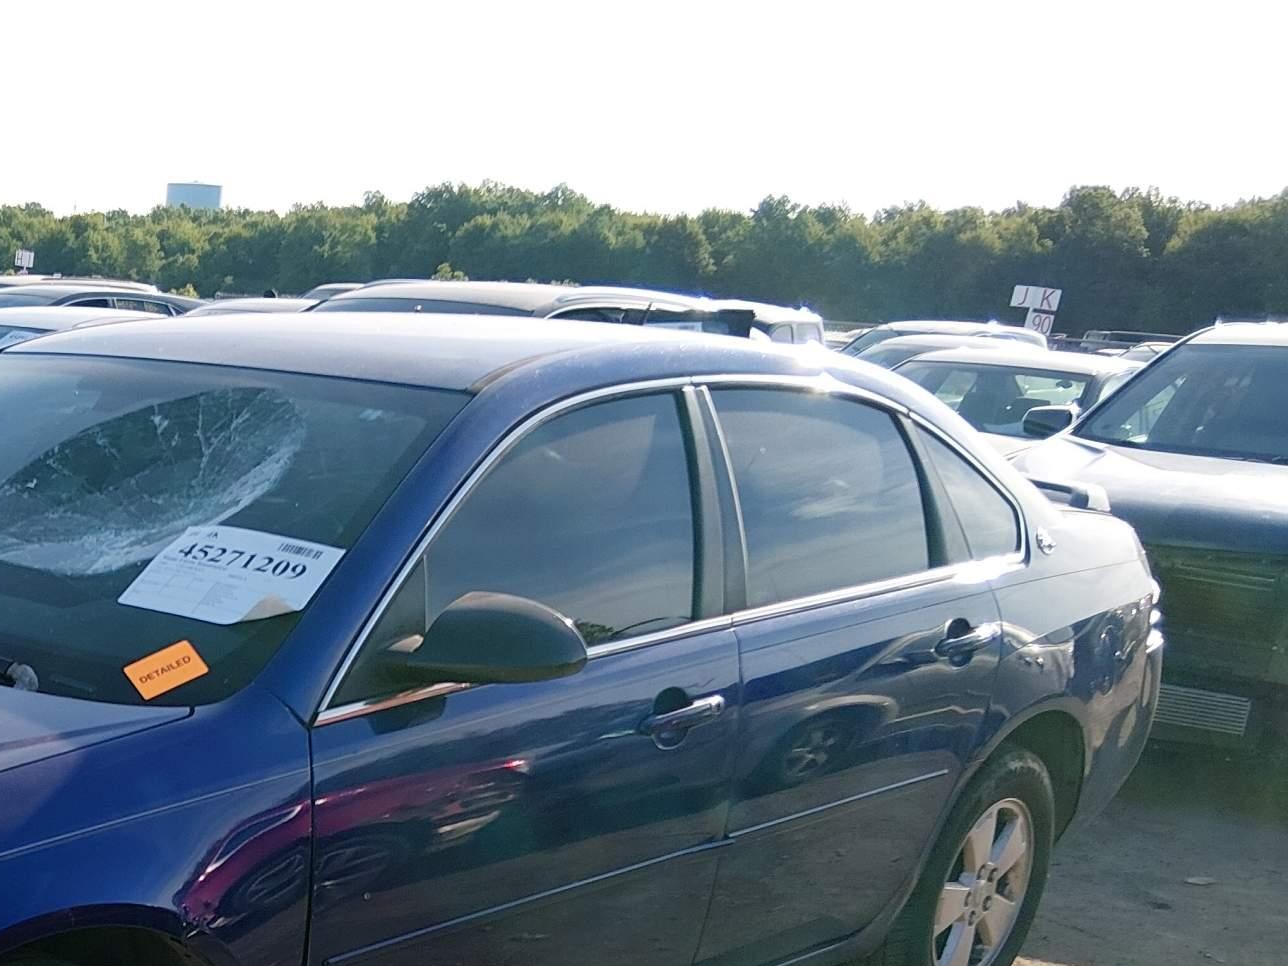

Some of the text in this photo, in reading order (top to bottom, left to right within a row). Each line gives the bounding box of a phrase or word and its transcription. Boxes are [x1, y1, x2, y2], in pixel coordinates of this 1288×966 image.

[1017, 288, 1056, 309] J K
[1033, 314, 1051, 334] 90
[177, 542, 307, 579] 45271209
[139, 655, 192, 684] DETAILED
